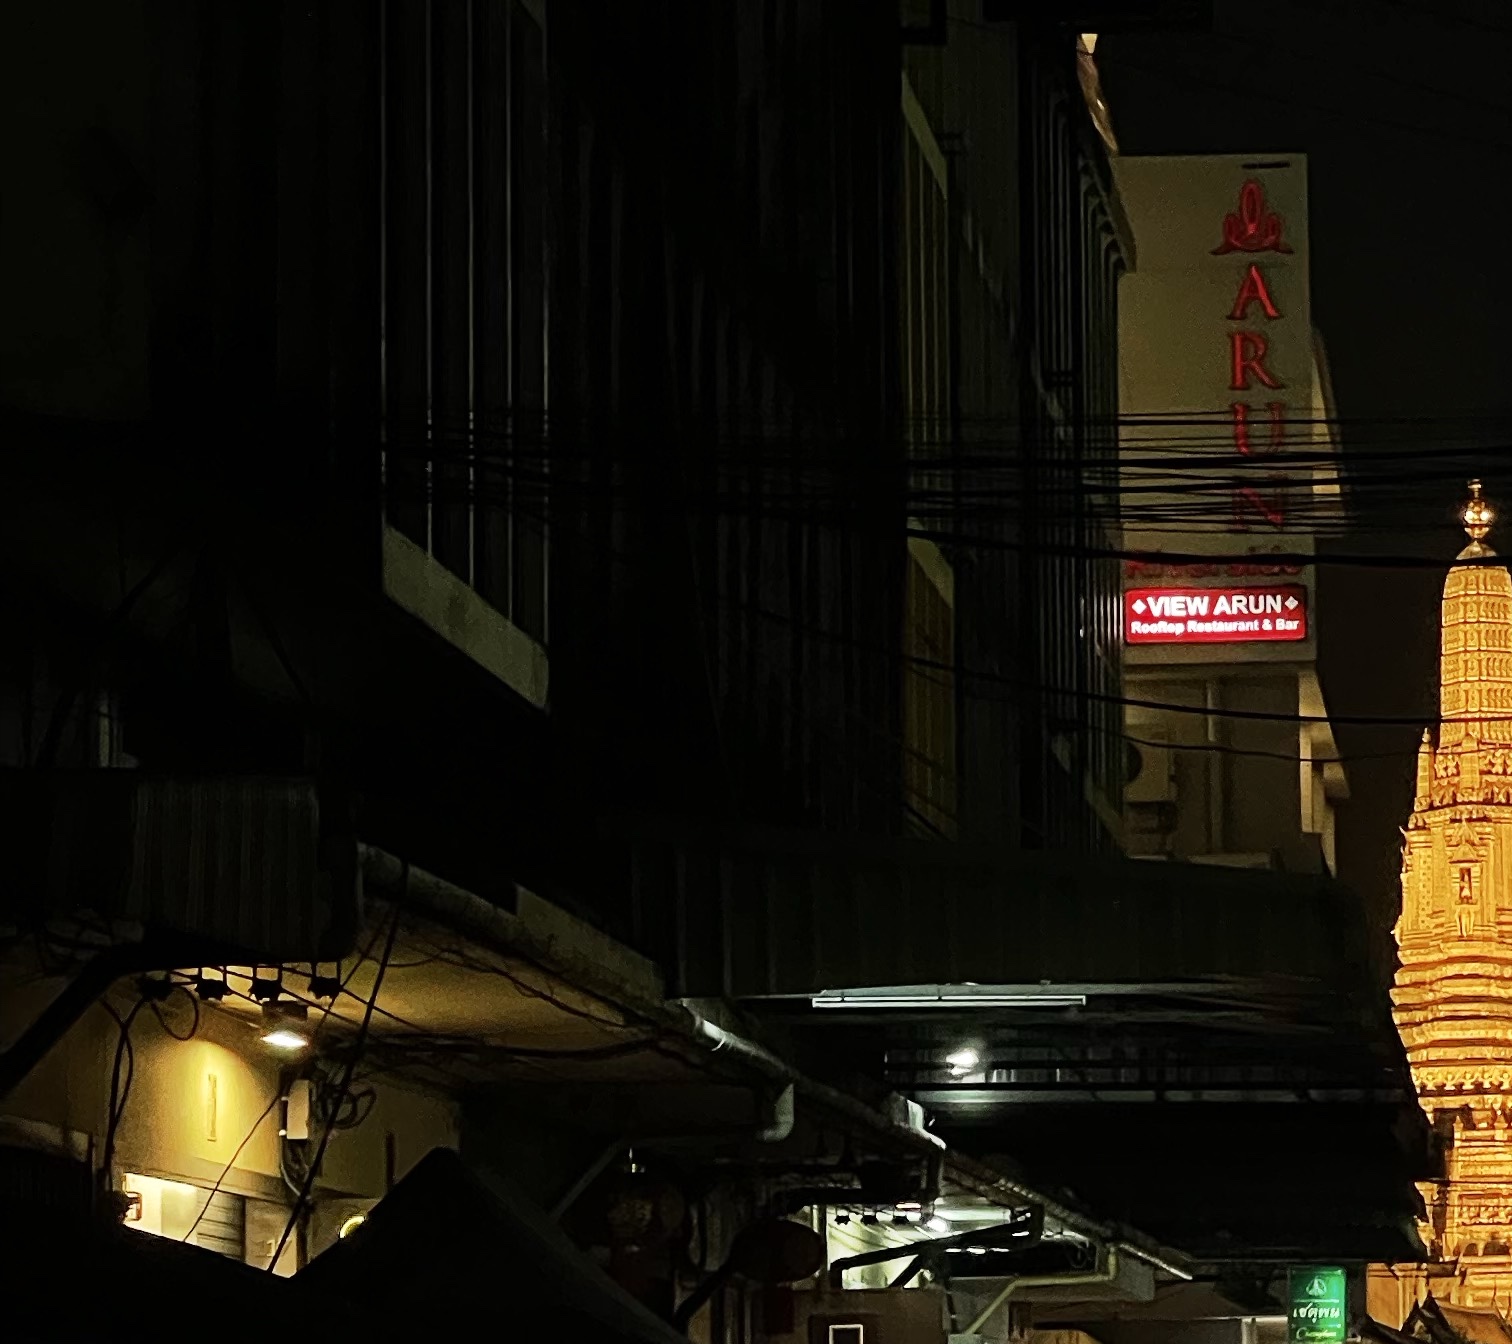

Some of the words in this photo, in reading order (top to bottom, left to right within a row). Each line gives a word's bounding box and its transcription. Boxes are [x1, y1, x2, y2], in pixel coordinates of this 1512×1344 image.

[1146, 595, 1210, 617] VIEW
[1212, 594, 1282, 616] ARUN
[1131, 620, 1185, 636] Rooftop
[1187, 618, 1259, 633] Restaurant
[1262, 618, 1272, 631] &
[1275, 618, 1300, 631] Bar
